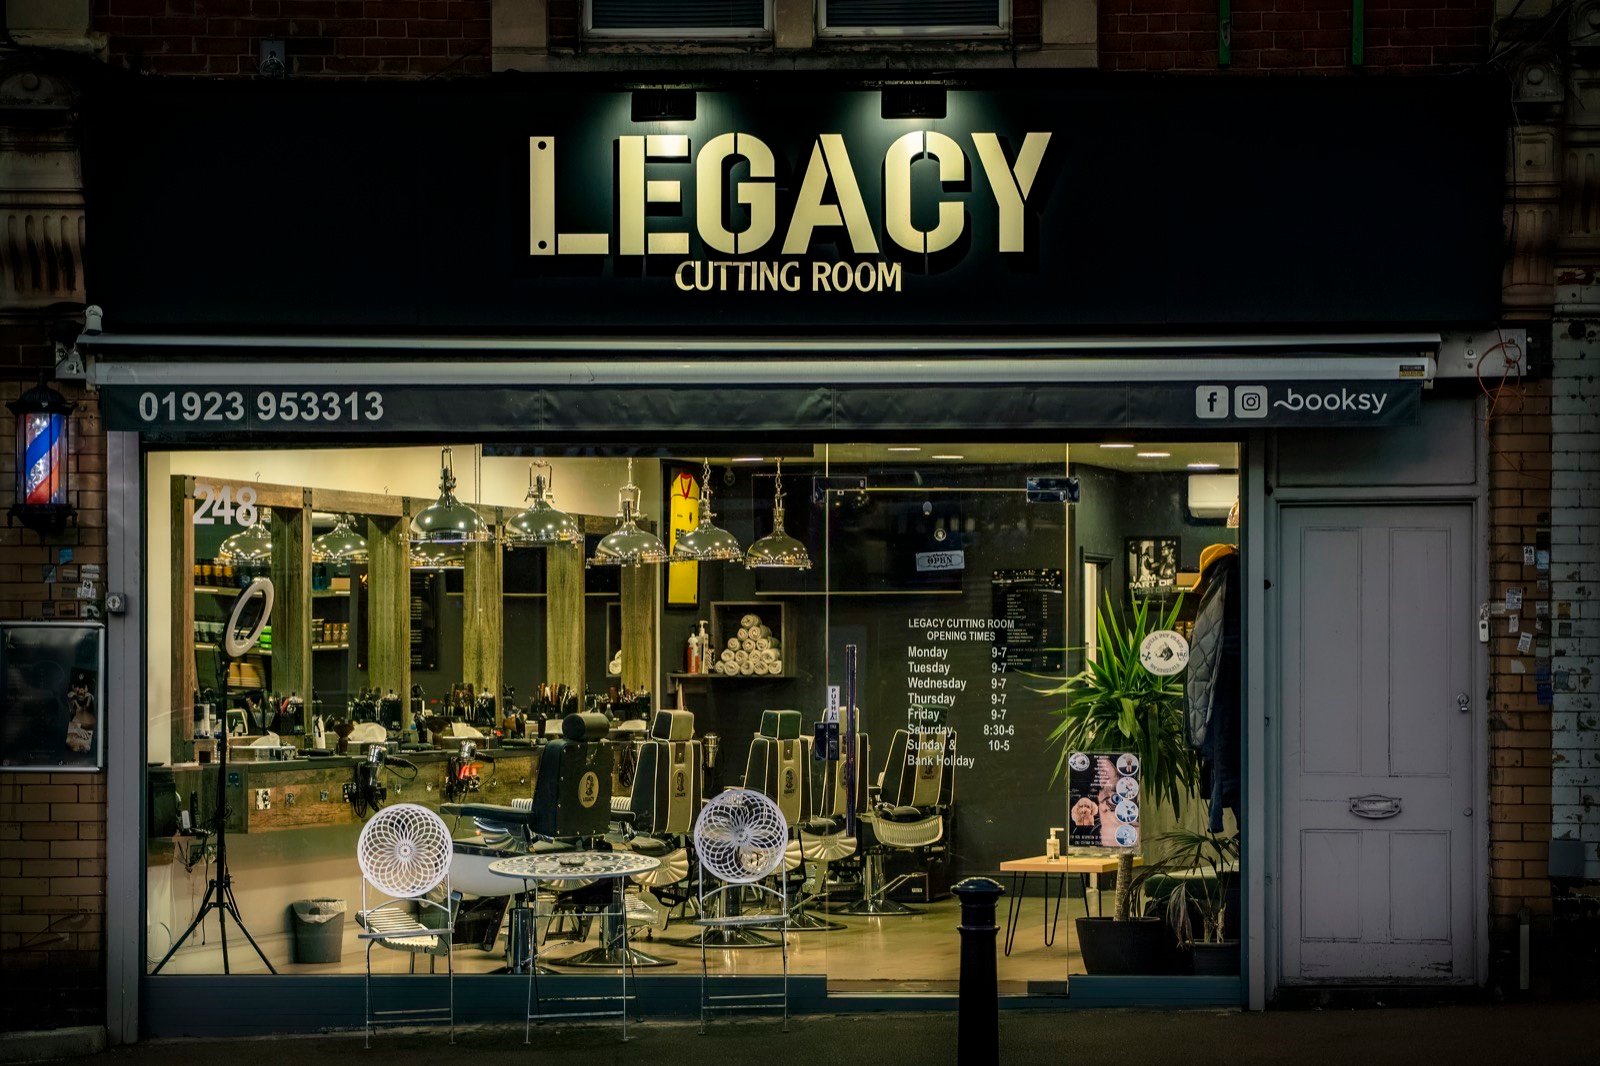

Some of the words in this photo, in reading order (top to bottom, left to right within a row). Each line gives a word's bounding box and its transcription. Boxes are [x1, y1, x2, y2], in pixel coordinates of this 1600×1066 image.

[530, 130, 1053, 256] LEGACY
[674, 260, 800, 292] CUTTING
[812, 261, 902, 293] ROOM
[138, 391, 245, 421] 01923
[256, 391, 384, 421] 953313
[1273, 388, 1387, 414] booksy
[192, 484, 258, 527] 248
[928, 556, 953, 566] OPEN
[908, 618, 945, 629] LEGACY
[946, 618, 985, 628] CUTTING
[987, 619, 1015, 629] ROOM
[927, 631, 968, 641] OPENING
[969, 631, 996, 641] TIMES
[908, 646, 948, 660] Monday
[991, 647, 1007, 658] 9-7
[908, 661, 950, 676] Tuesday
[991, 662, 1007, 674] 9-7
[907, 677, 967, 691] Wednesday
[991, 678, 1007, 689] 9-7
[907, 692, 956, 707] Thursday
[991, 693, 1007, 705] 9-7
[907, 708, 940, 722] Friday
[991, 709, 1007, 720] 9-7
[907, 724, 953, 738] Saturday
[983, 725, 1015, 736] 8:30-6
[907, 739, 945, 753] Sunday
[949, 740, 956, 751] &
[988, 740, 1010, 751] 10-5
[907, 755, 934, 766] Bank
[936, 755, 975, 769] Holiday
